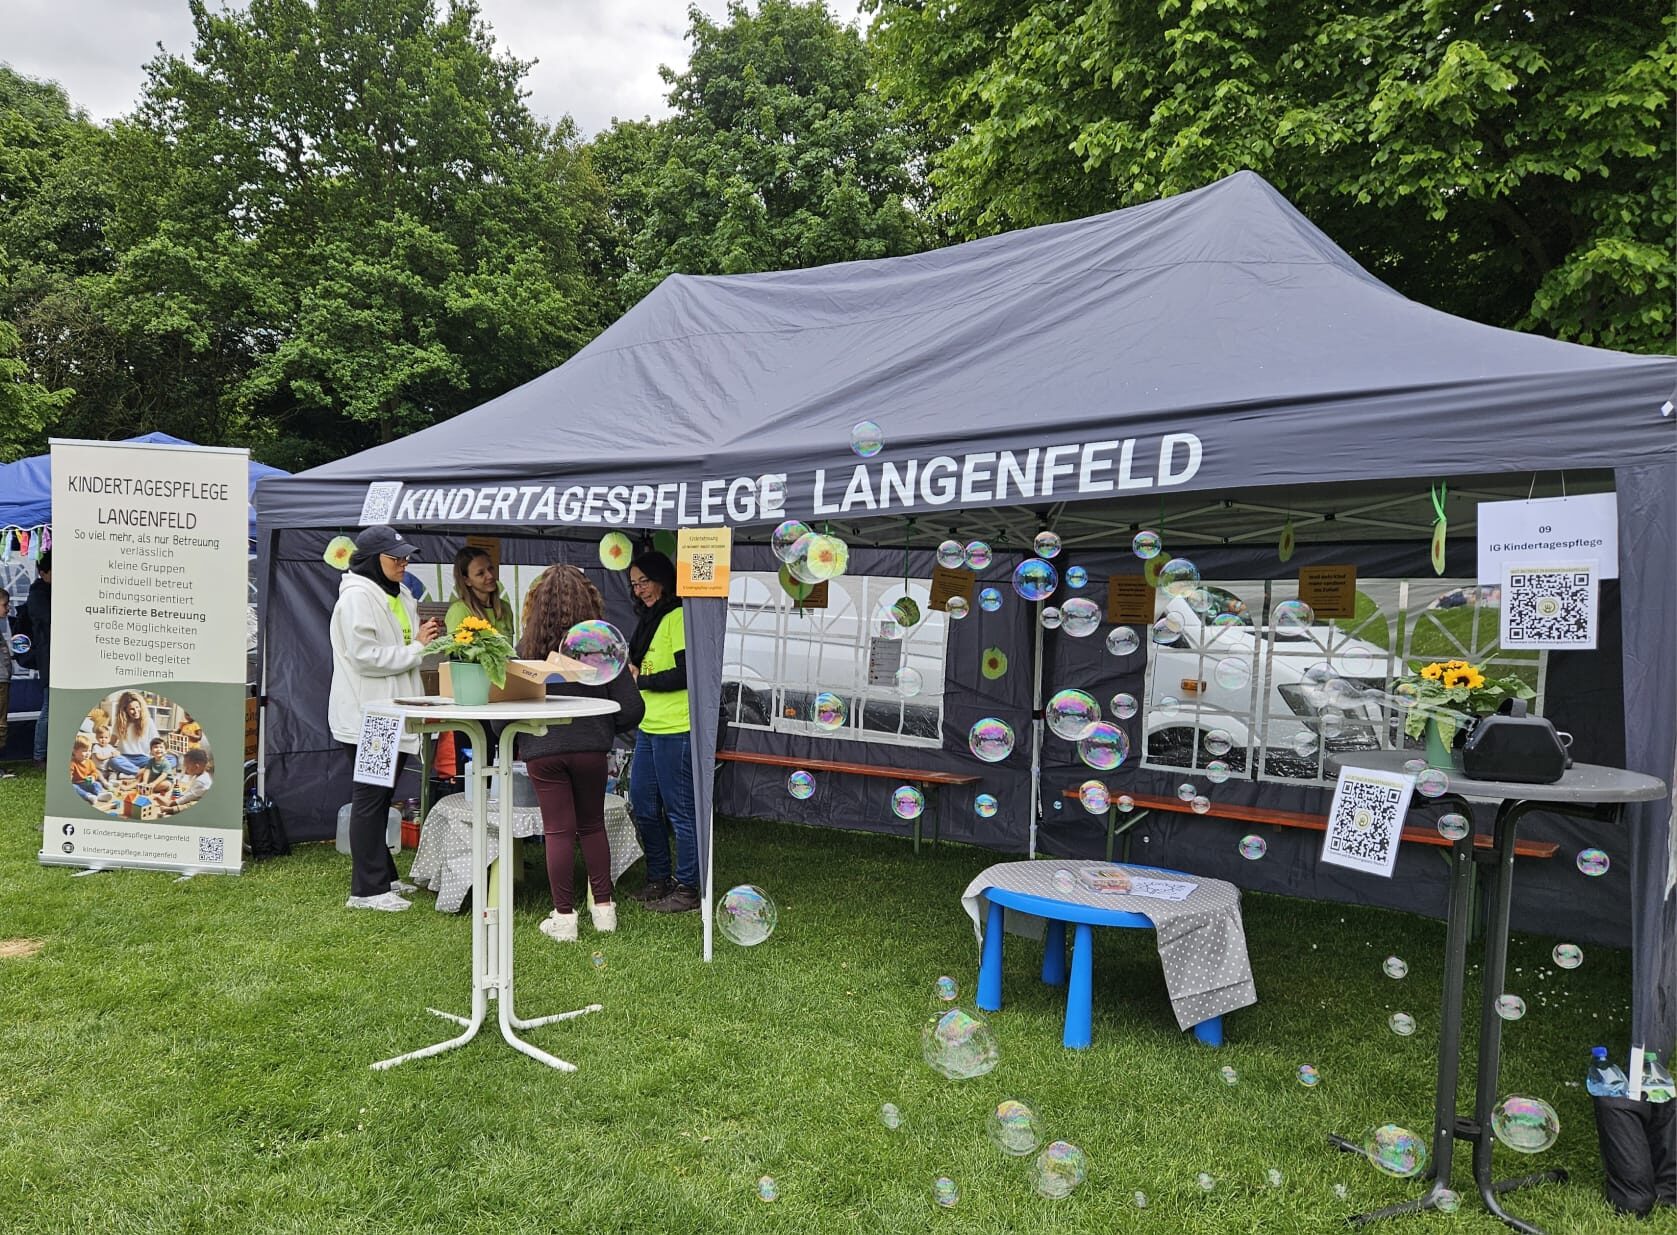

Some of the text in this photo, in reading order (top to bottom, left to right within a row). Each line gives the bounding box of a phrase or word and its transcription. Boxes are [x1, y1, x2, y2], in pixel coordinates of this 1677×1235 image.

[396, 433, 1203, 525] KINDERTAGESPFLEGE LANGENFELD
[68, 475, 229, 501] KINDERTAGESPFLEGE
[98, 508, 197, 529] LANGENFELD
[1539, 526, 1552, 534] 09
[74, 530, 219, 550] So viel mehr, als nur Betreuung
[1504, 538, 1603, 551] Kindertagespflege
[120, 546, 173, 558] verlässlich
[108, 561, 185, 574] kleine Gruppen
[100, 576, 193, 590] individuell betreut
[99, 591, 194, 605] bindungsorientiert
[85, 606, 206, 622] qualifizierte Betreuung
[94, 622, 197, 635] große Möglichkeiten
[95, 636, 196, 651] feste Bezugsperson
[100, 650, 191, 665] liebevoll begleitet
[116, 667, 174, 679] familiennah
[93, 830, 152, 841] Kindertagespflege
[154, 833, 190, 842] Langenfeld
